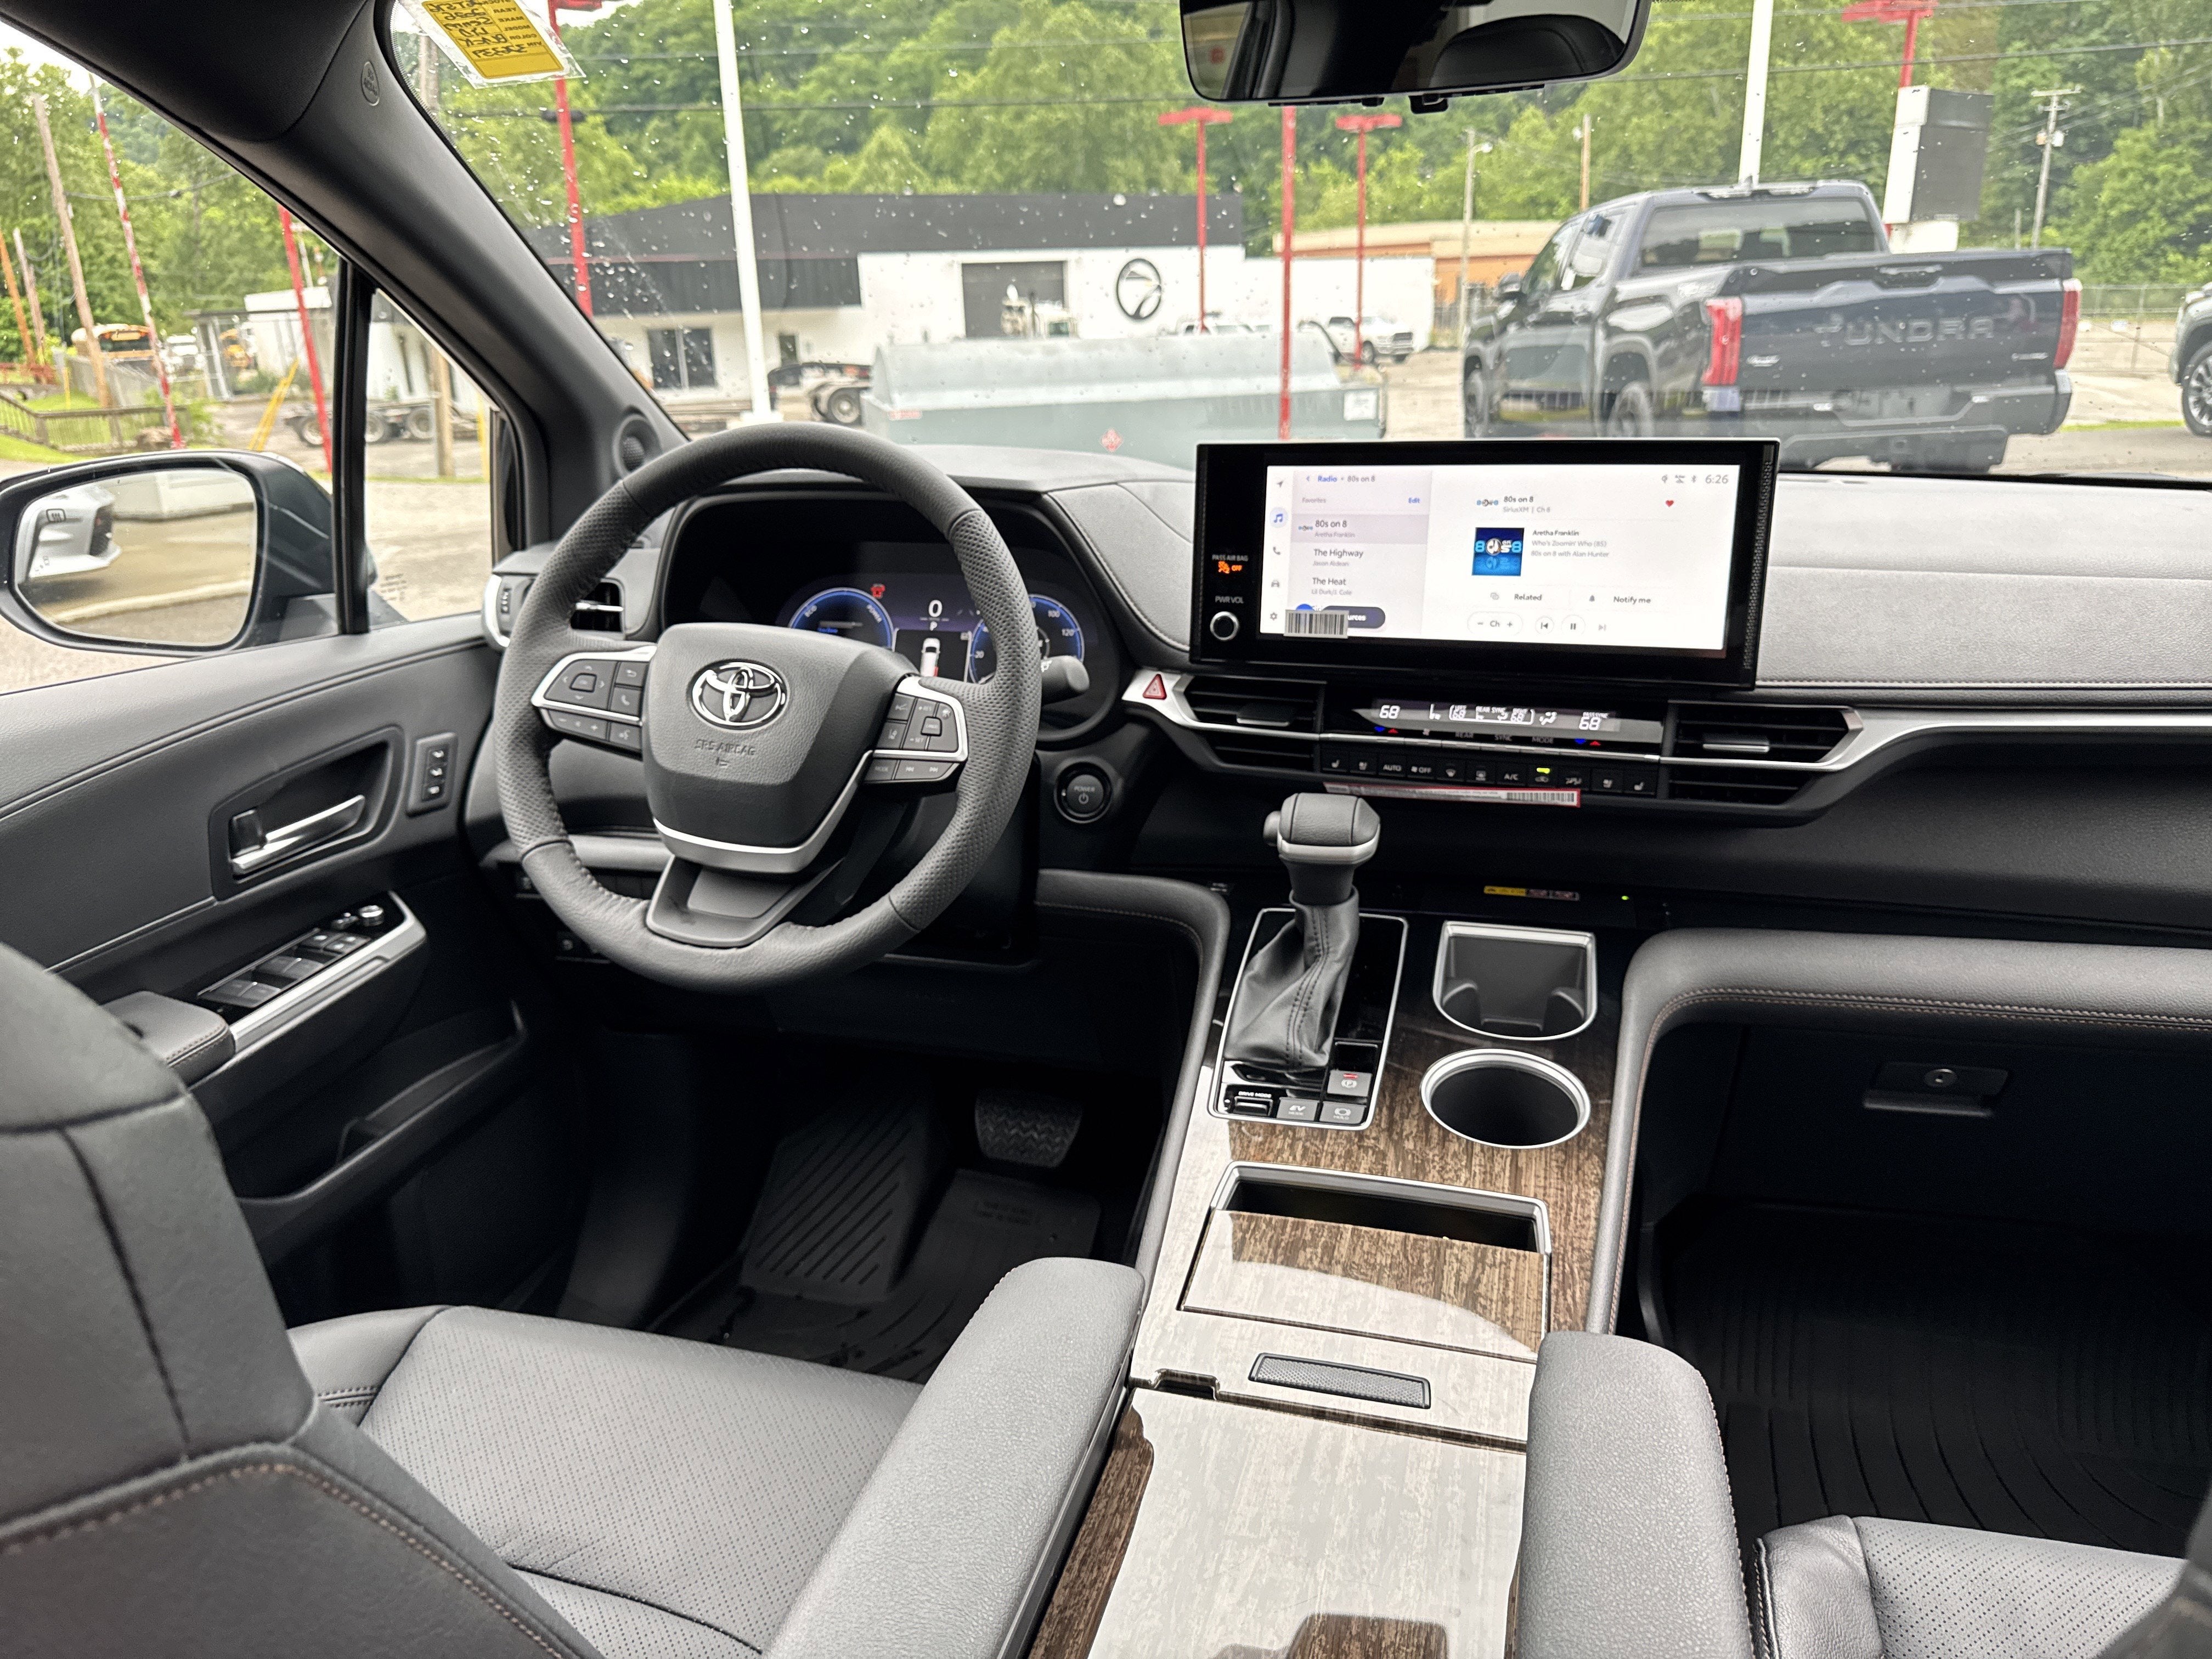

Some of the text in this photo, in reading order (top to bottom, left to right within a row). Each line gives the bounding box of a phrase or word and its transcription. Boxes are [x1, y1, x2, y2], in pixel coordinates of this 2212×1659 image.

[1705, 474, 1729, 484] 6:26
[1329, 549, 1364, 558] Highway
[1514, 593, 1542, 601] Related
[1613, 596, 1637, 605] Notify
[928, 599, 943, 618] 0
[929, 620, 938, 631] P
[1379, 704, 1400, 719] 68
[1578, 716, 1602, 731] 68
